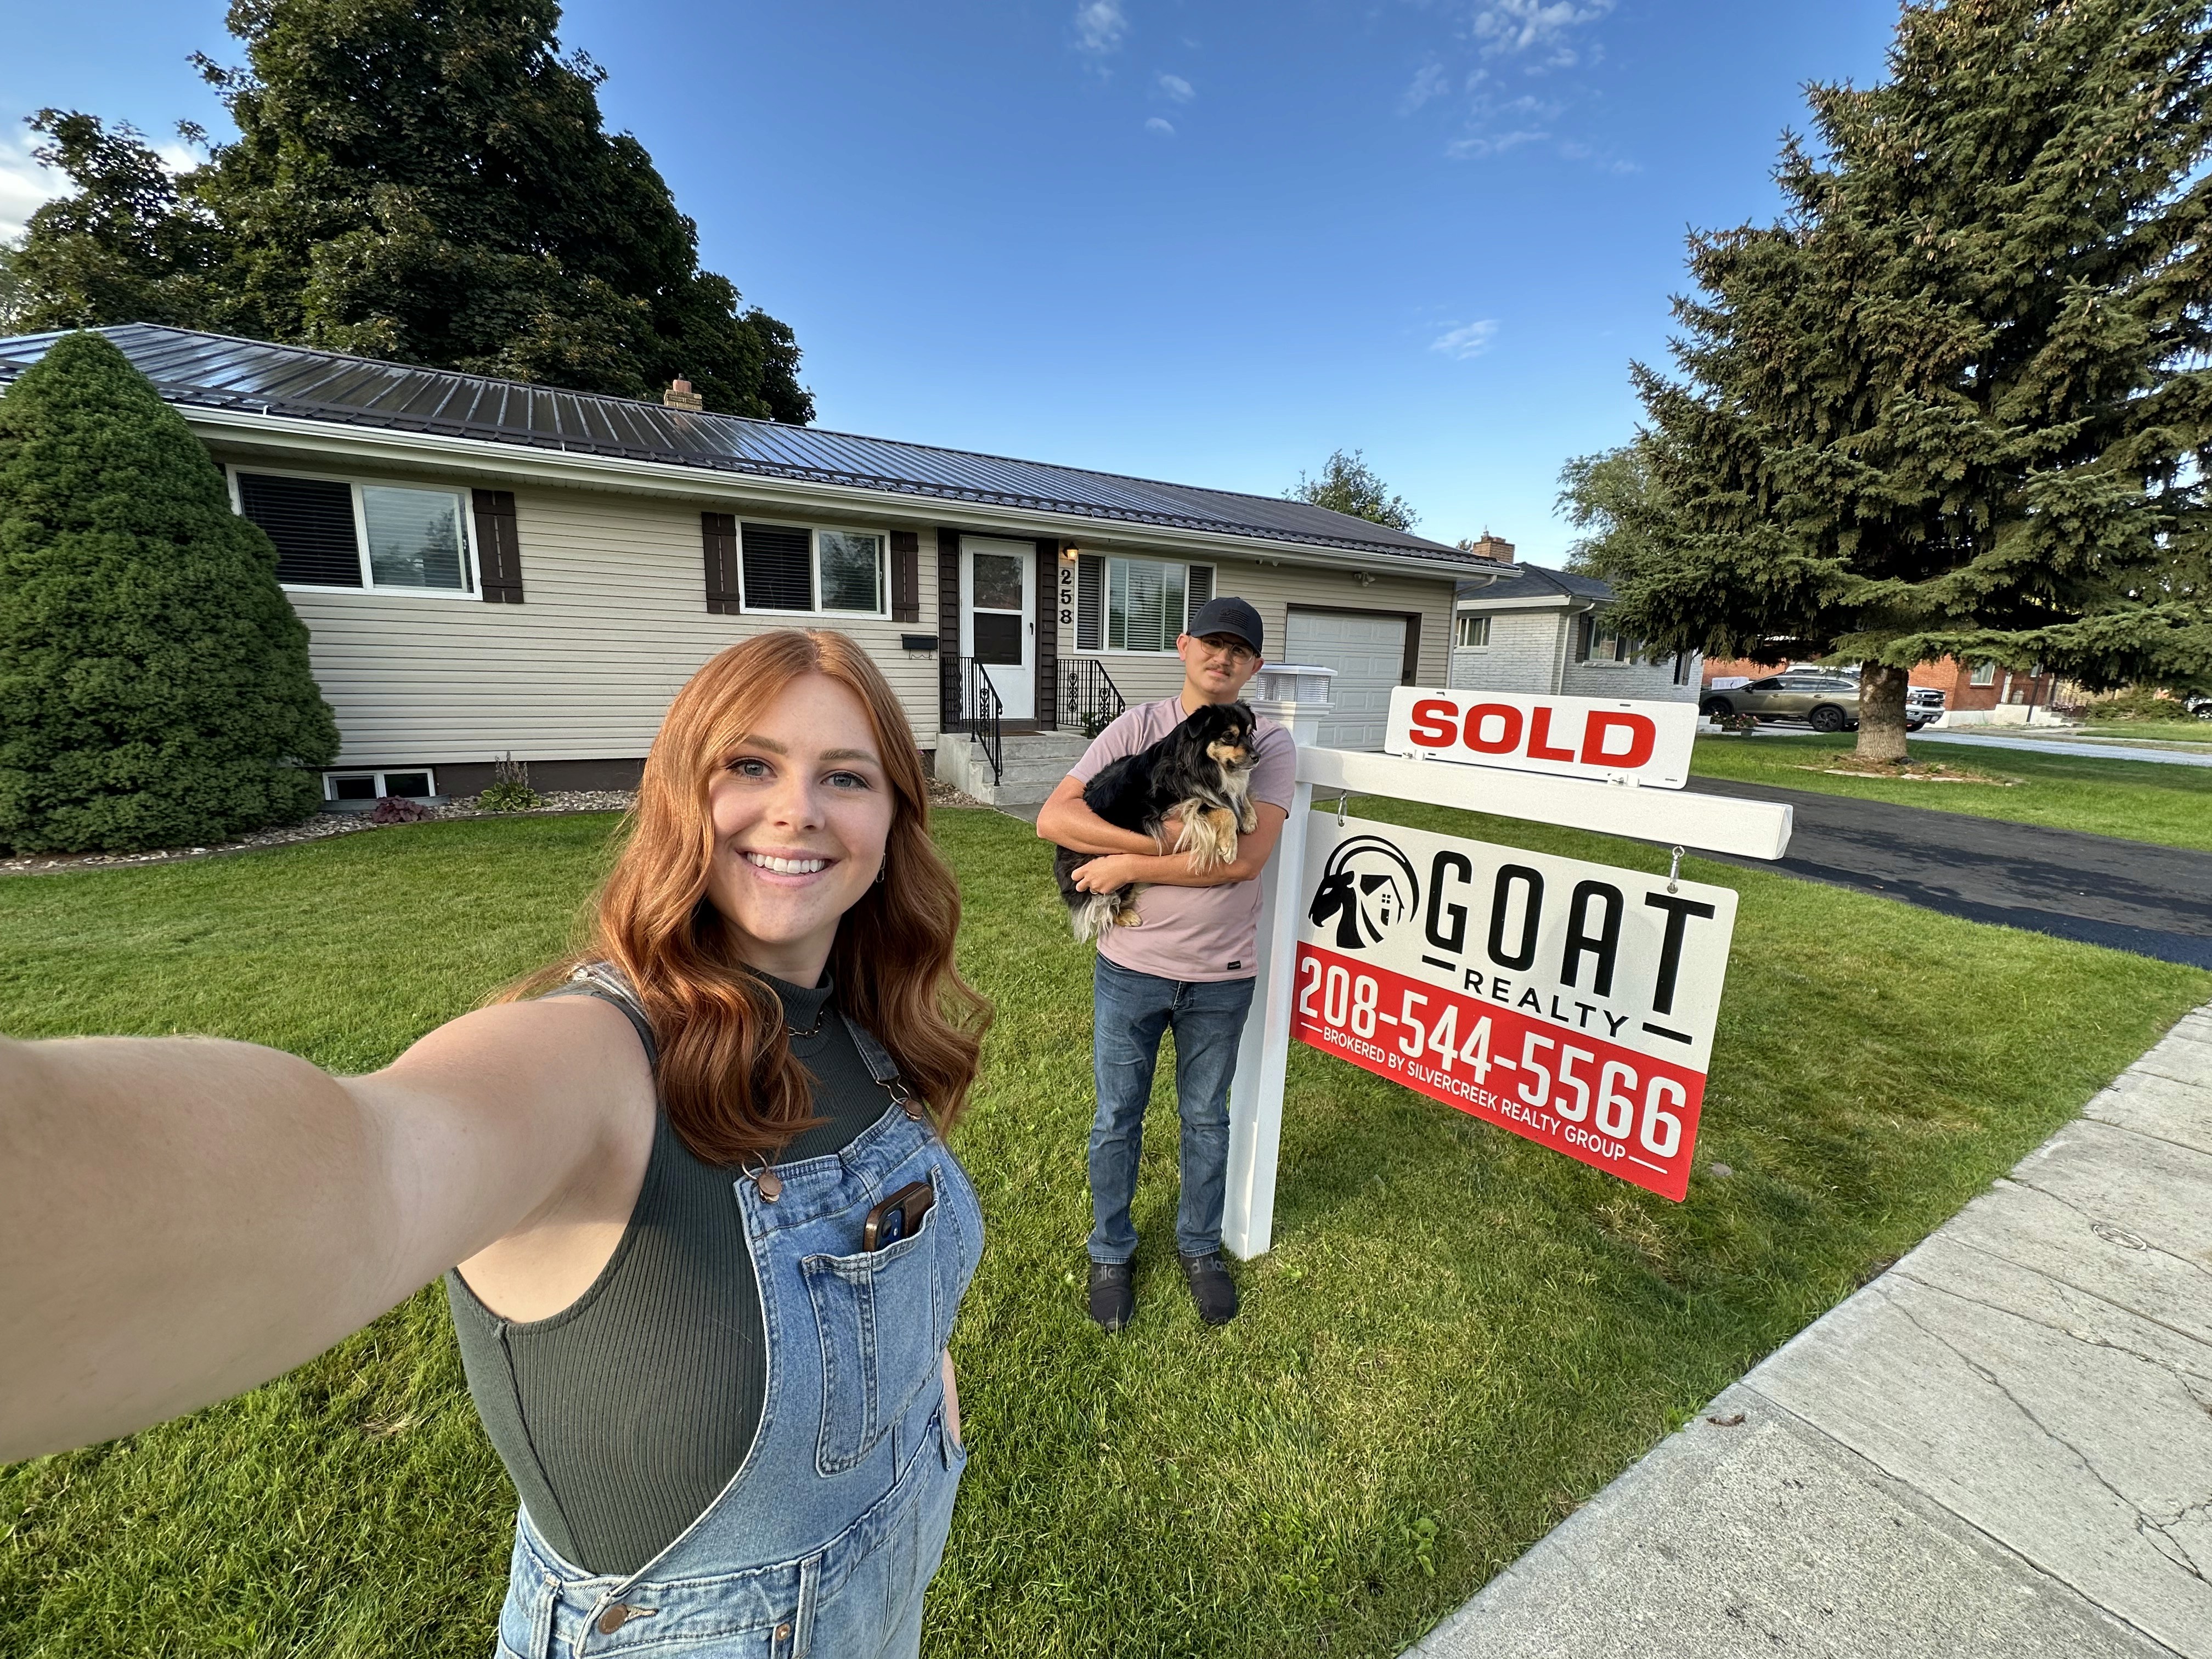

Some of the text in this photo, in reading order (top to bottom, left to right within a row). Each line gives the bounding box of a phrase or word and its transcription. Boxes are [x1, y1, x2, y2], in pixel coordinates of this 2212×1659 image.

[1060, 569, 1073, 624] 258
[1409, 699, 1656, 768] SOLD
[1425, 850, 1716, 1016] GOAT
[1464, 968, 1630, 1039] REALTY
[1299, 956, 1687, 1158] 208-544-5566
[1323, 1025, 1626, 1161] BROKERED BY SILVERCREEK REALTY GROUP
